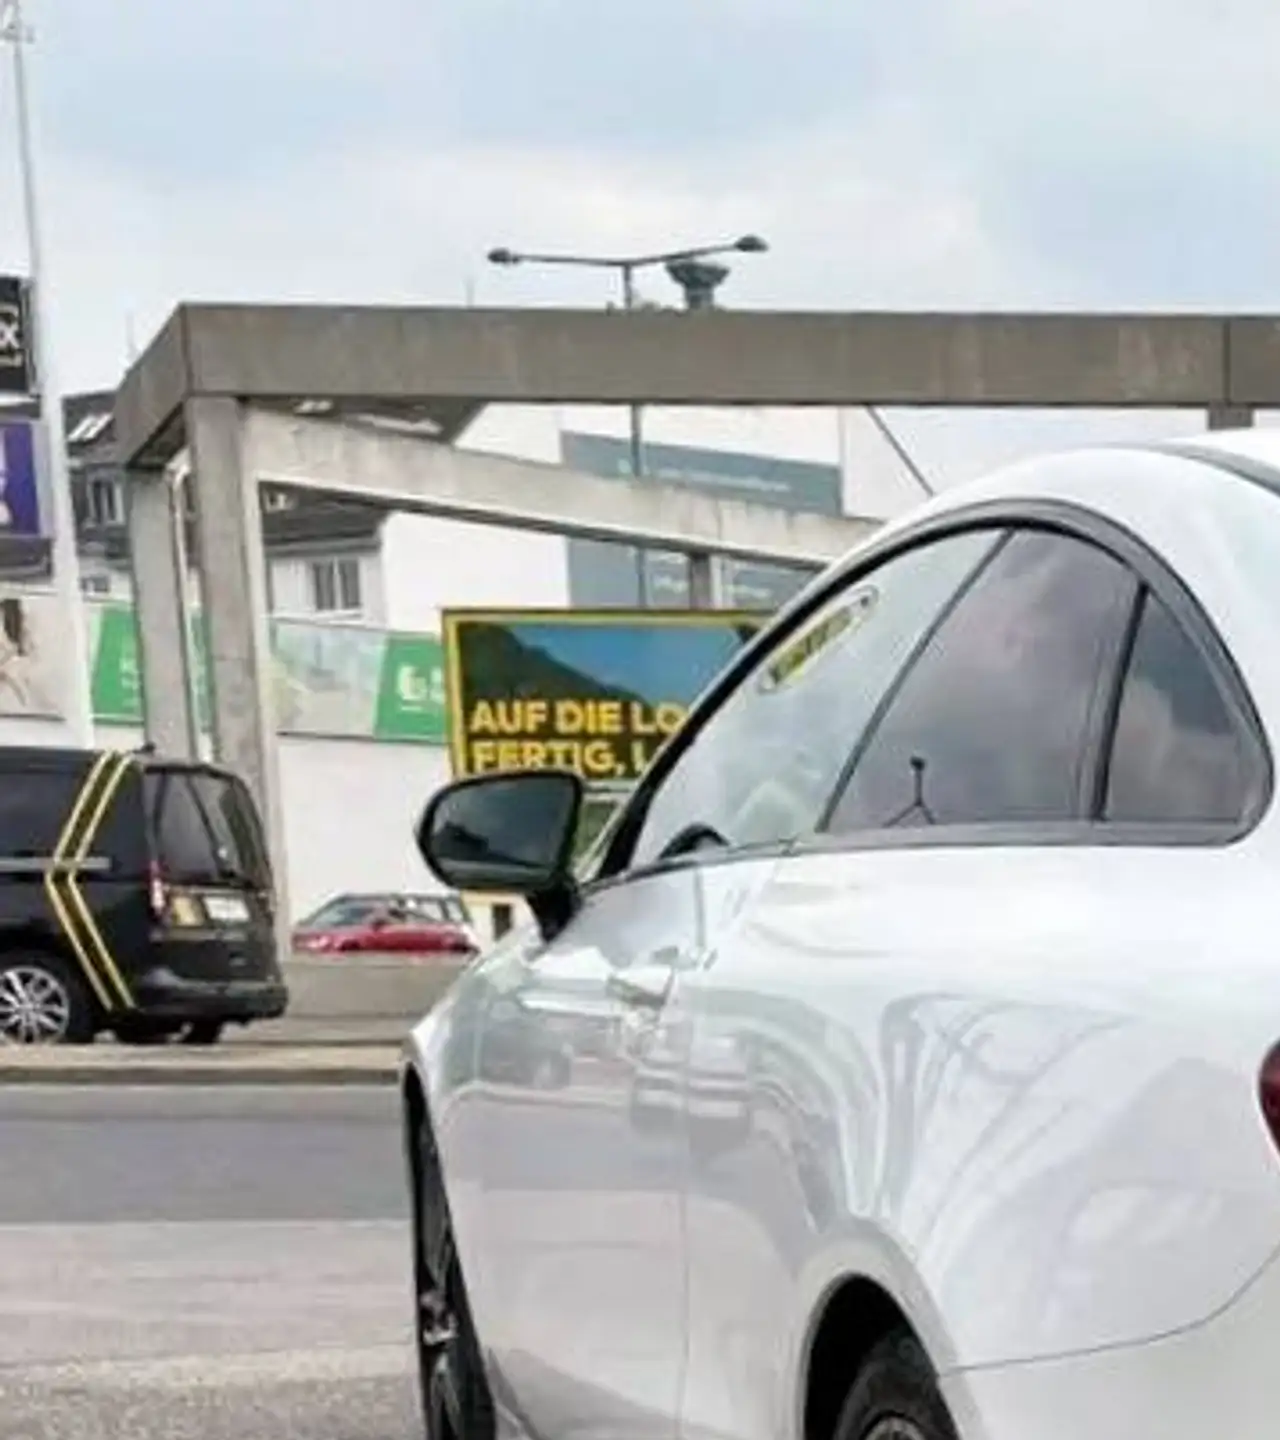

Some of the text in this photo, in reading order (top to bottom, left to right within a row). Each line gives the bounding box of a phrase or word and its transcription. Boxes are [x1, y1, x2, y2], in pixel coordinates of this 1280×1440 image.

[470, 700, 546, 734] AUF
[556, 700, 623, 733] DIE
[474, 740, 626, 775] FERTIG,
